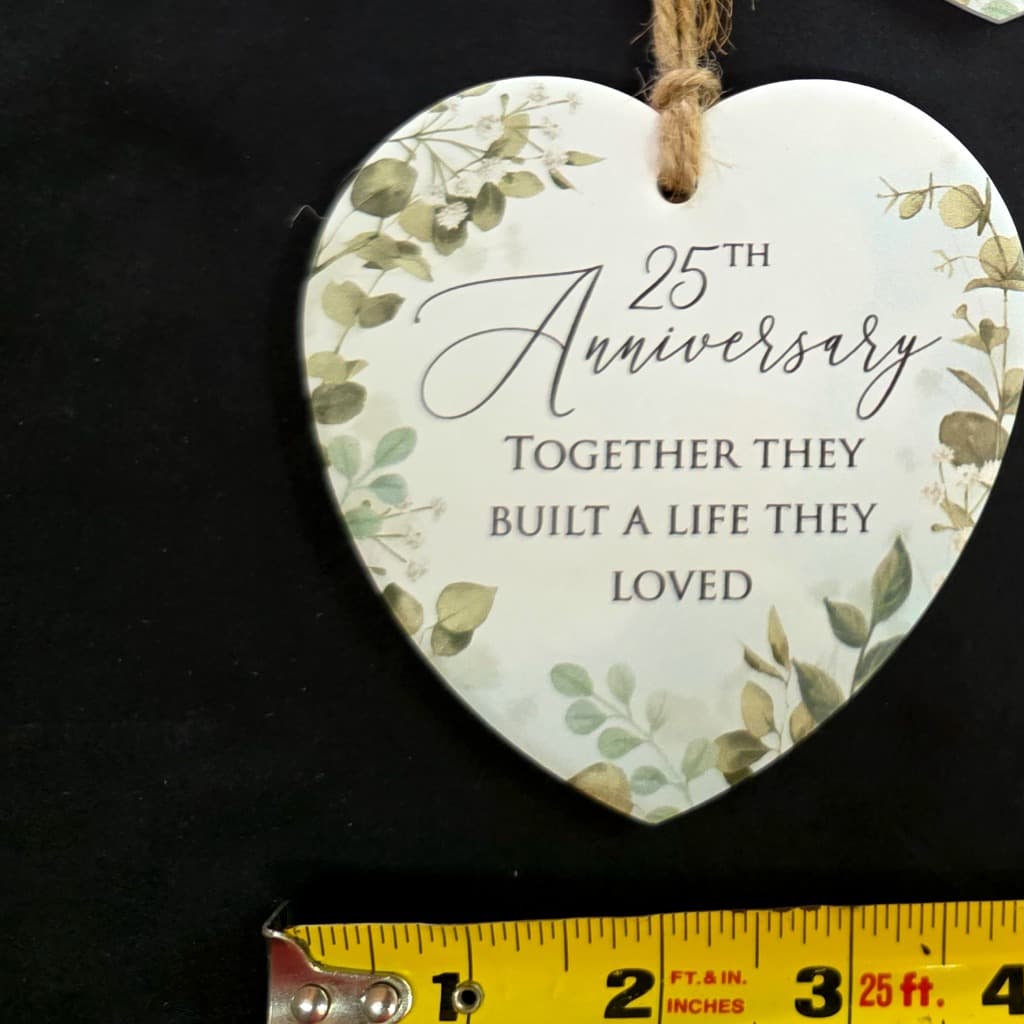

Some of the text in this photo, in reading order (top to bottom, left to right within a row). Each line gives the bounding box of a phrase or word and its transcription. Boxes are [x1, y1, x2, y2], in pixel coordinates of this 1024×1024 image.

[414, 264, 942, 420] Anniversary
[504, 434, 865, 472] TOGETHER THEY
[489, 502, 877, 537] BUILT A LIFE THEY
[612, 569, 753, 602] LOVED
[432, 972, 460, 1022] 1
[603, 967, 656, 1019] 2
[667, 998, 745, 1015] INCHES
[794, 965, 843, 1018] 3
[859, 971, 945, 1008] 25 ft.
